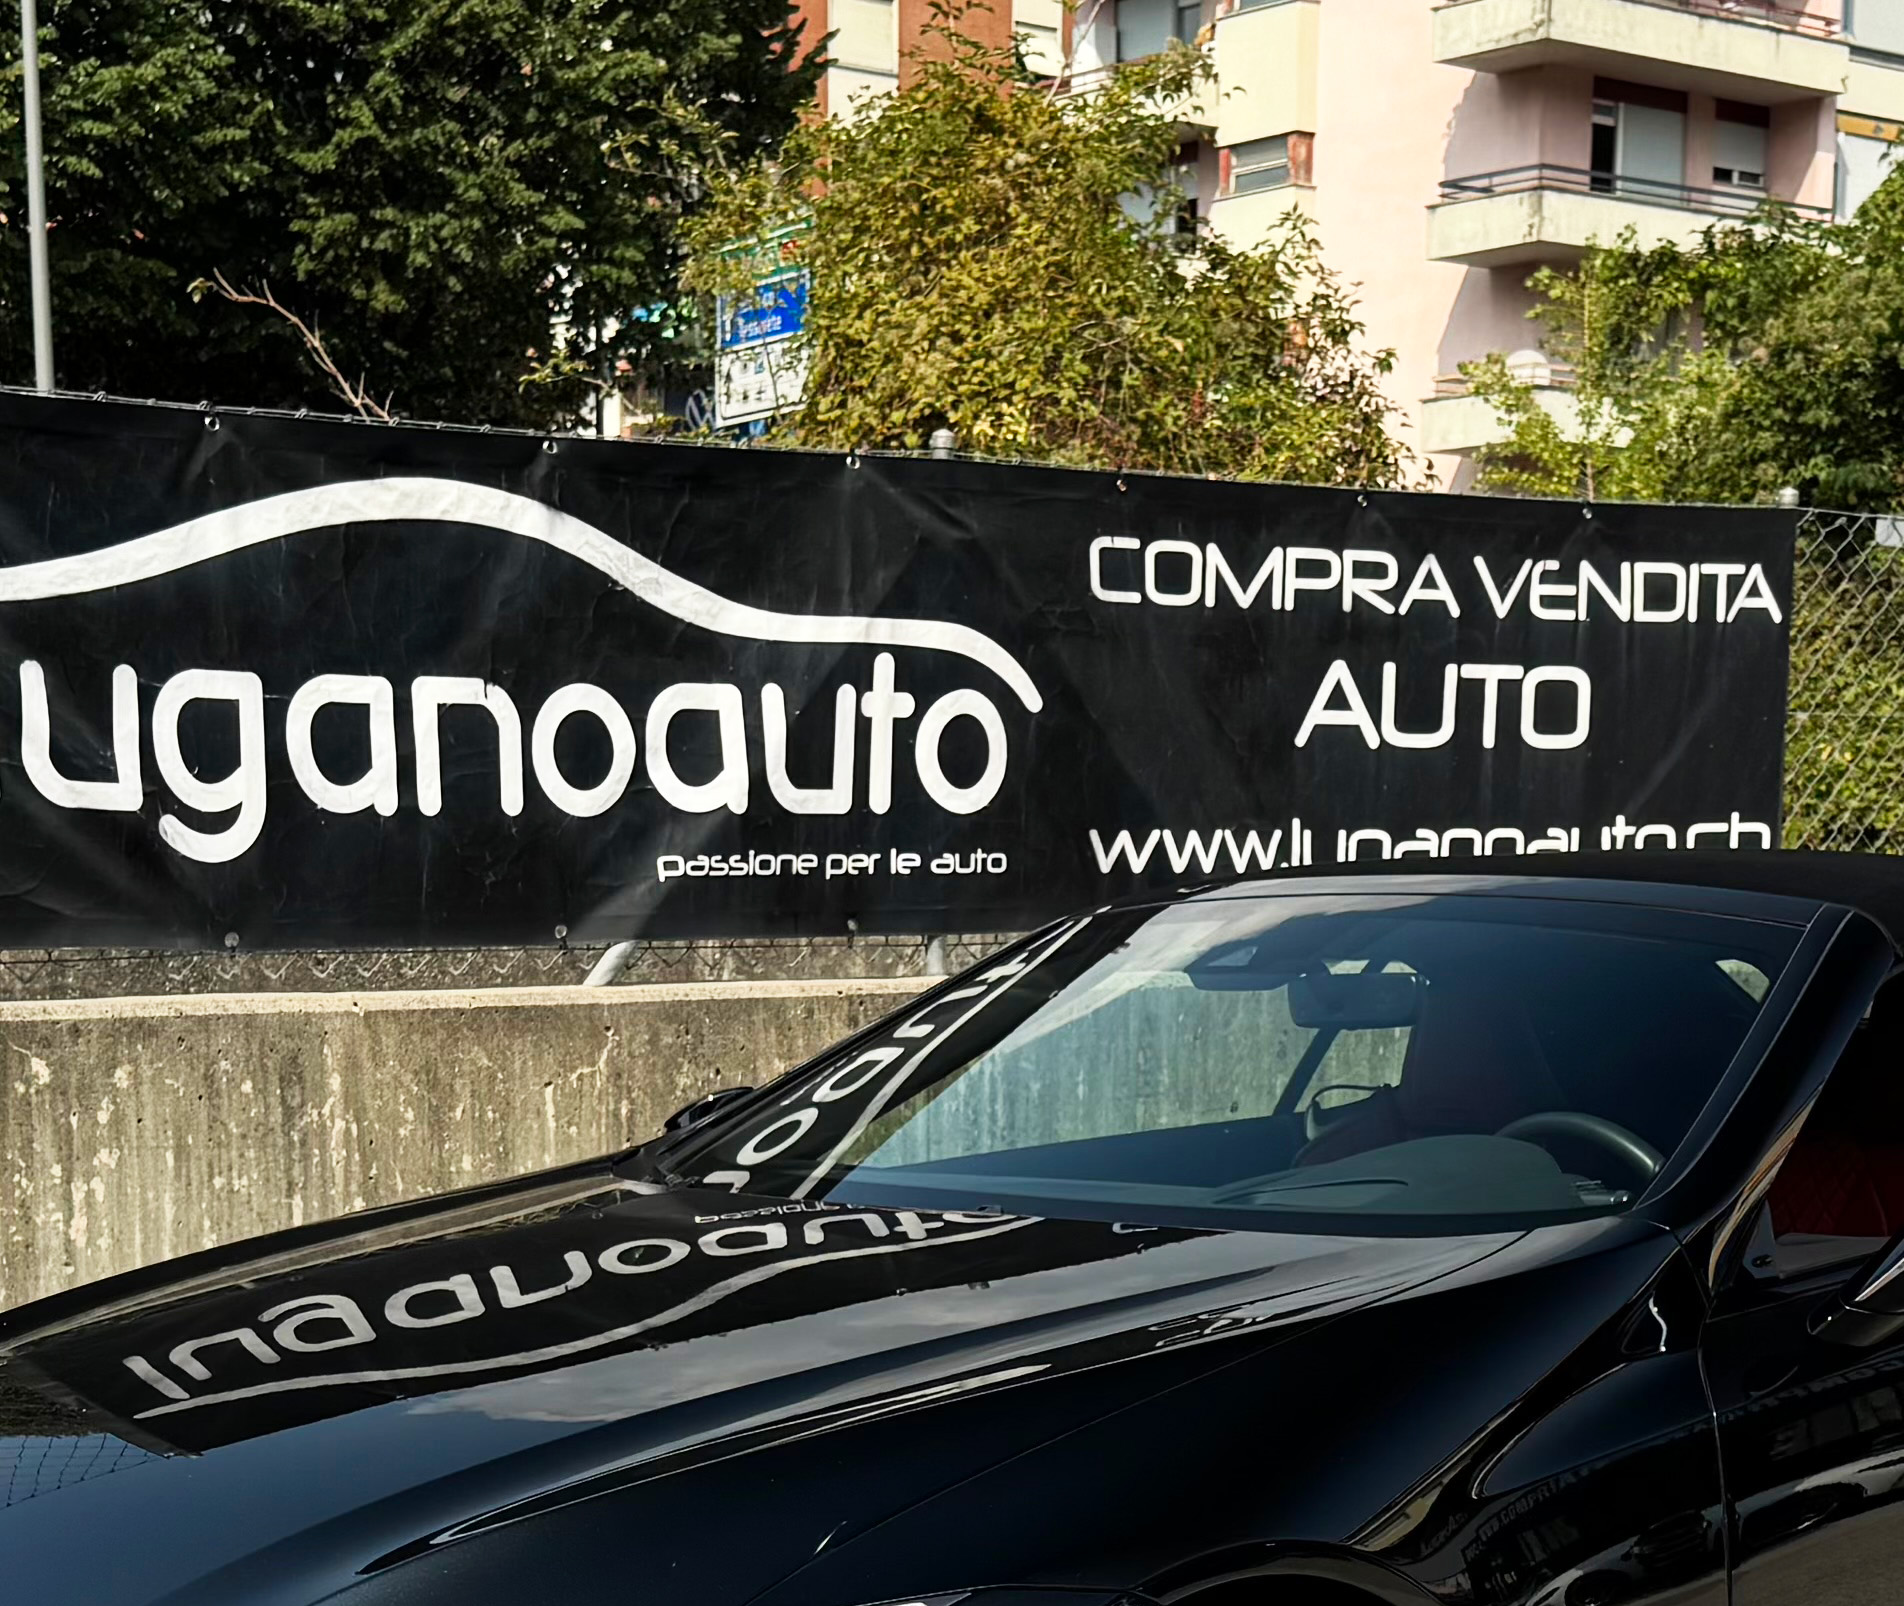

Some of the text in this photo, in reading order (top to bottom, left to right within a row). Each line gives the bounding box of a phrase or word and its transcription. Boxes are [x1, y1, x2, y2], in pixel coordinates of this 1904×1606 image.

[1089, 536, 1782, 624] COMPRA VENDITA
[1295, 659, 1591, 750] AUTO
[656, 848, 1008, 882] passione per le auto
[1089, 811, 1771, 874] www.luanoautoch
